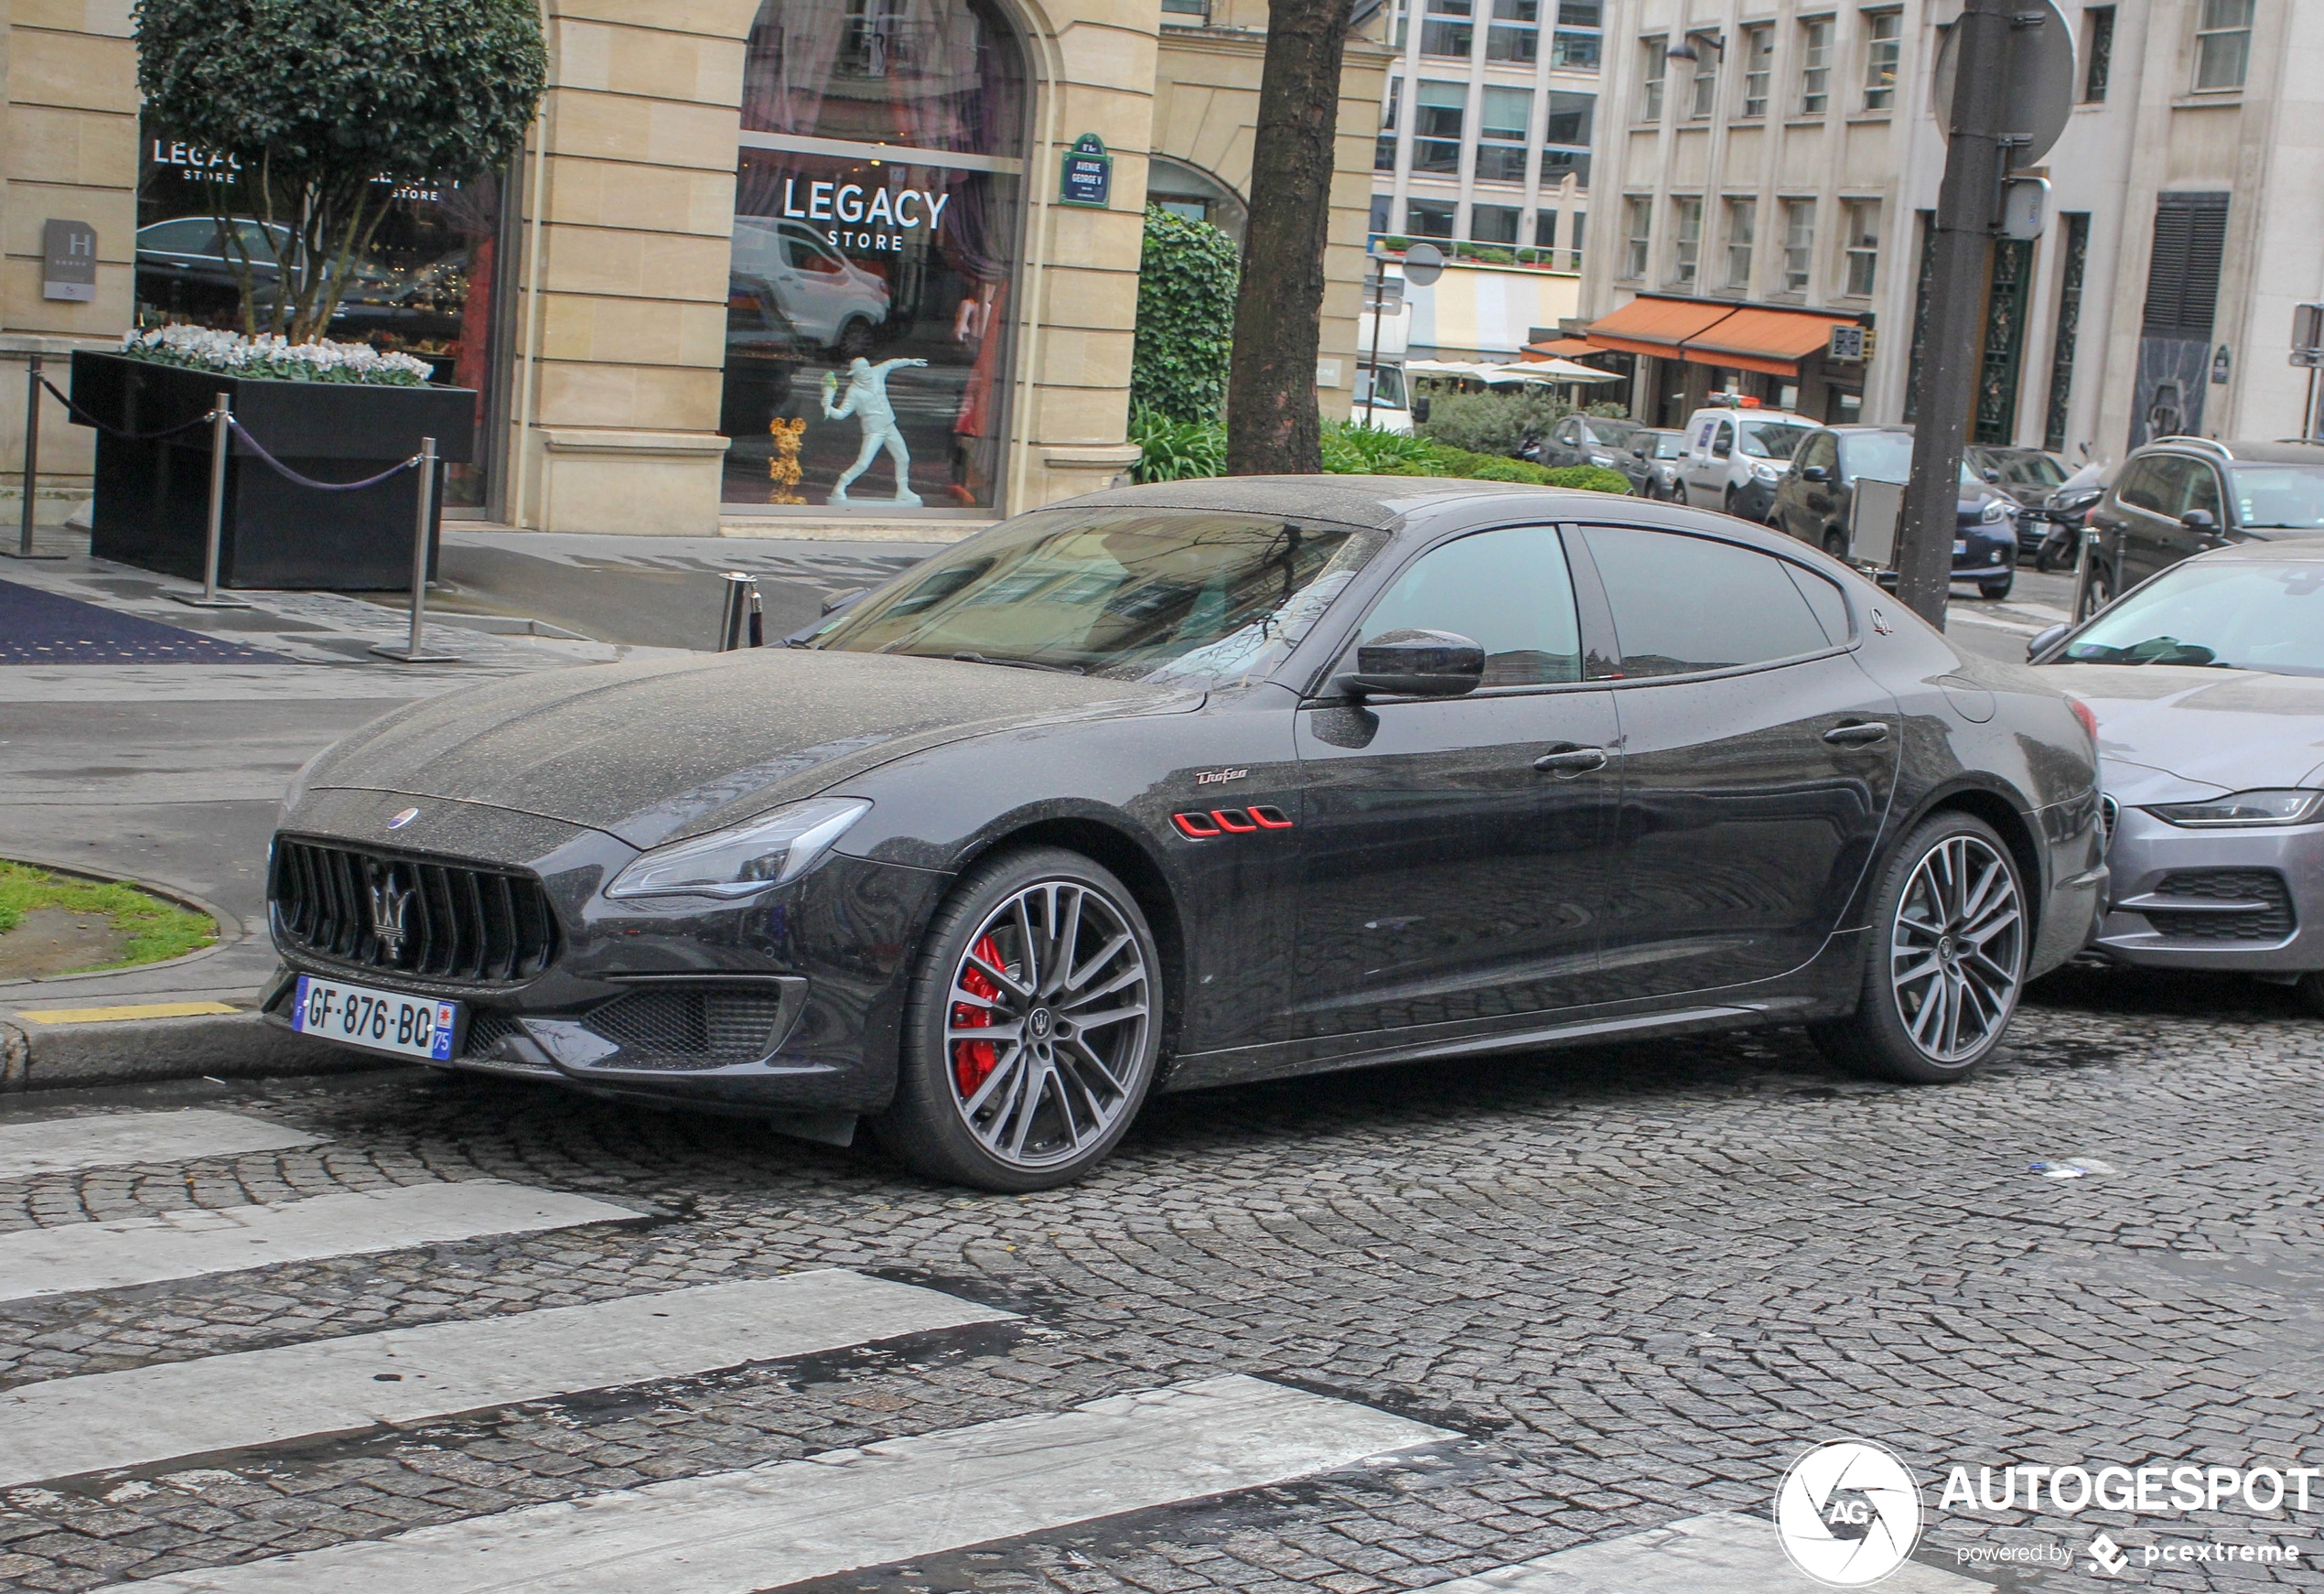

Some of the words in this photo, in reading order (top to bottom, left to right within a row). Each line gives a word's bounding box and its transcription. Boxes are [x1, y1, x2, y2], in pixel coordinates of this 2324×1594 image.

[1076, 161, 1101, 173] AVENUE
[1071, 173, 1097, 185] GEORGE
[1097, 176, 1103, 185] V
[392, 188, 439, 202] STORE
[783, 178, 950, 230] LEGACY
[70, 232, 91, 256] H
[827, 230, 903, 252] STORE
[1195, 768, 1249, 785] Trofeo
[308, 986, 432, 1049] GF-876-BQ
[434, 1030, 450, 1051] 75
